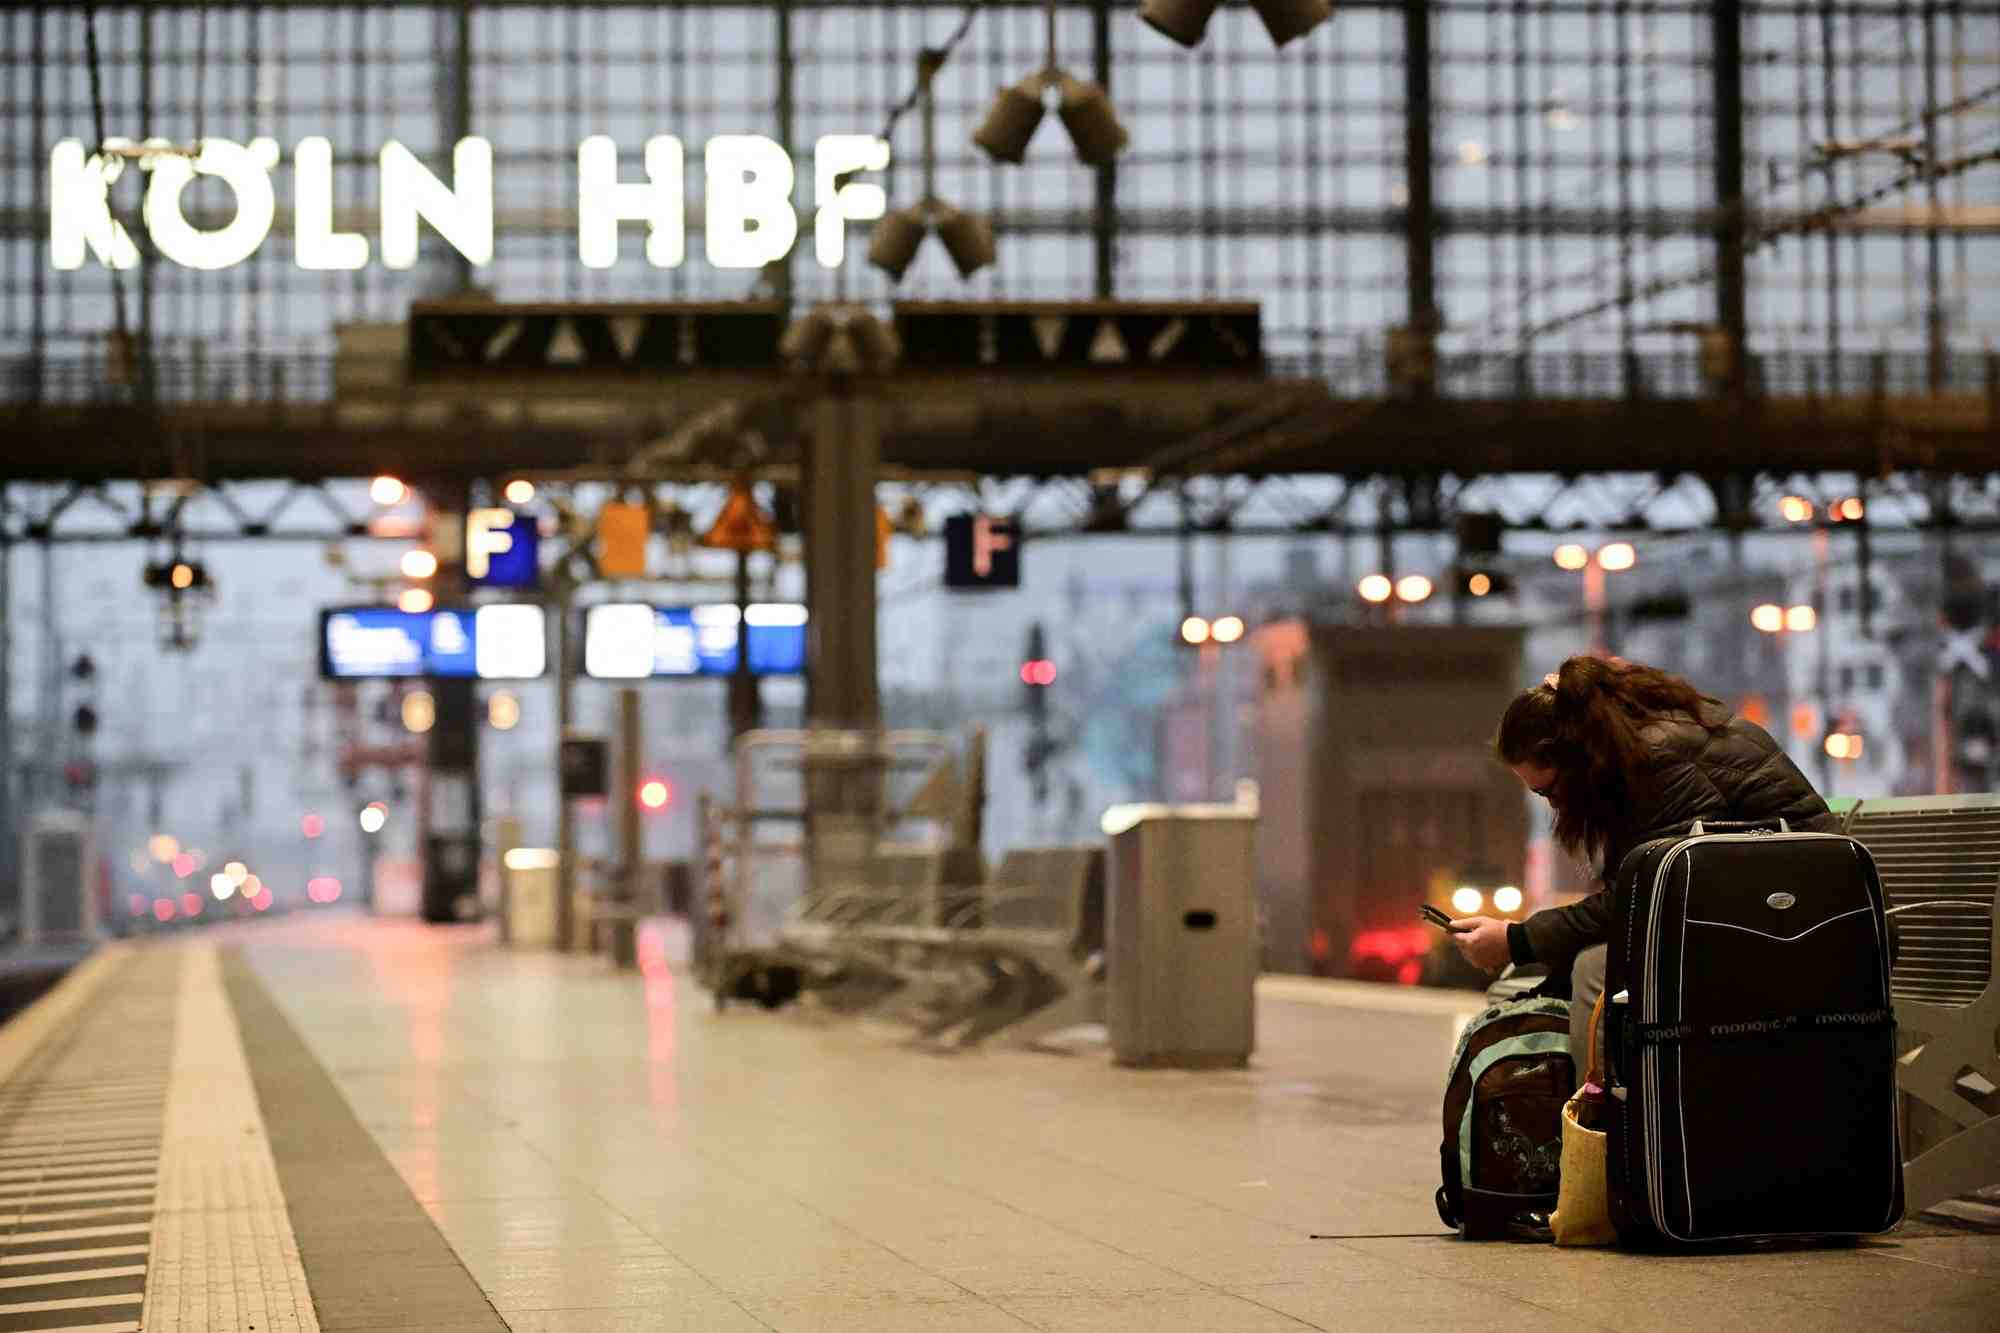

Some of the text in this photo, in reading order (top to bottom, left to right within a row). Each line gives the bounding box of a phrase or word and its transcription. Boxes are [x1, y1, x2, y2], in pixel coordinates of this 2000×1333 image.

[51, 135, 890, 270] KÖLN HBF
[466, 508, 514, 578] F
[973, 512, 1011, 576] F
